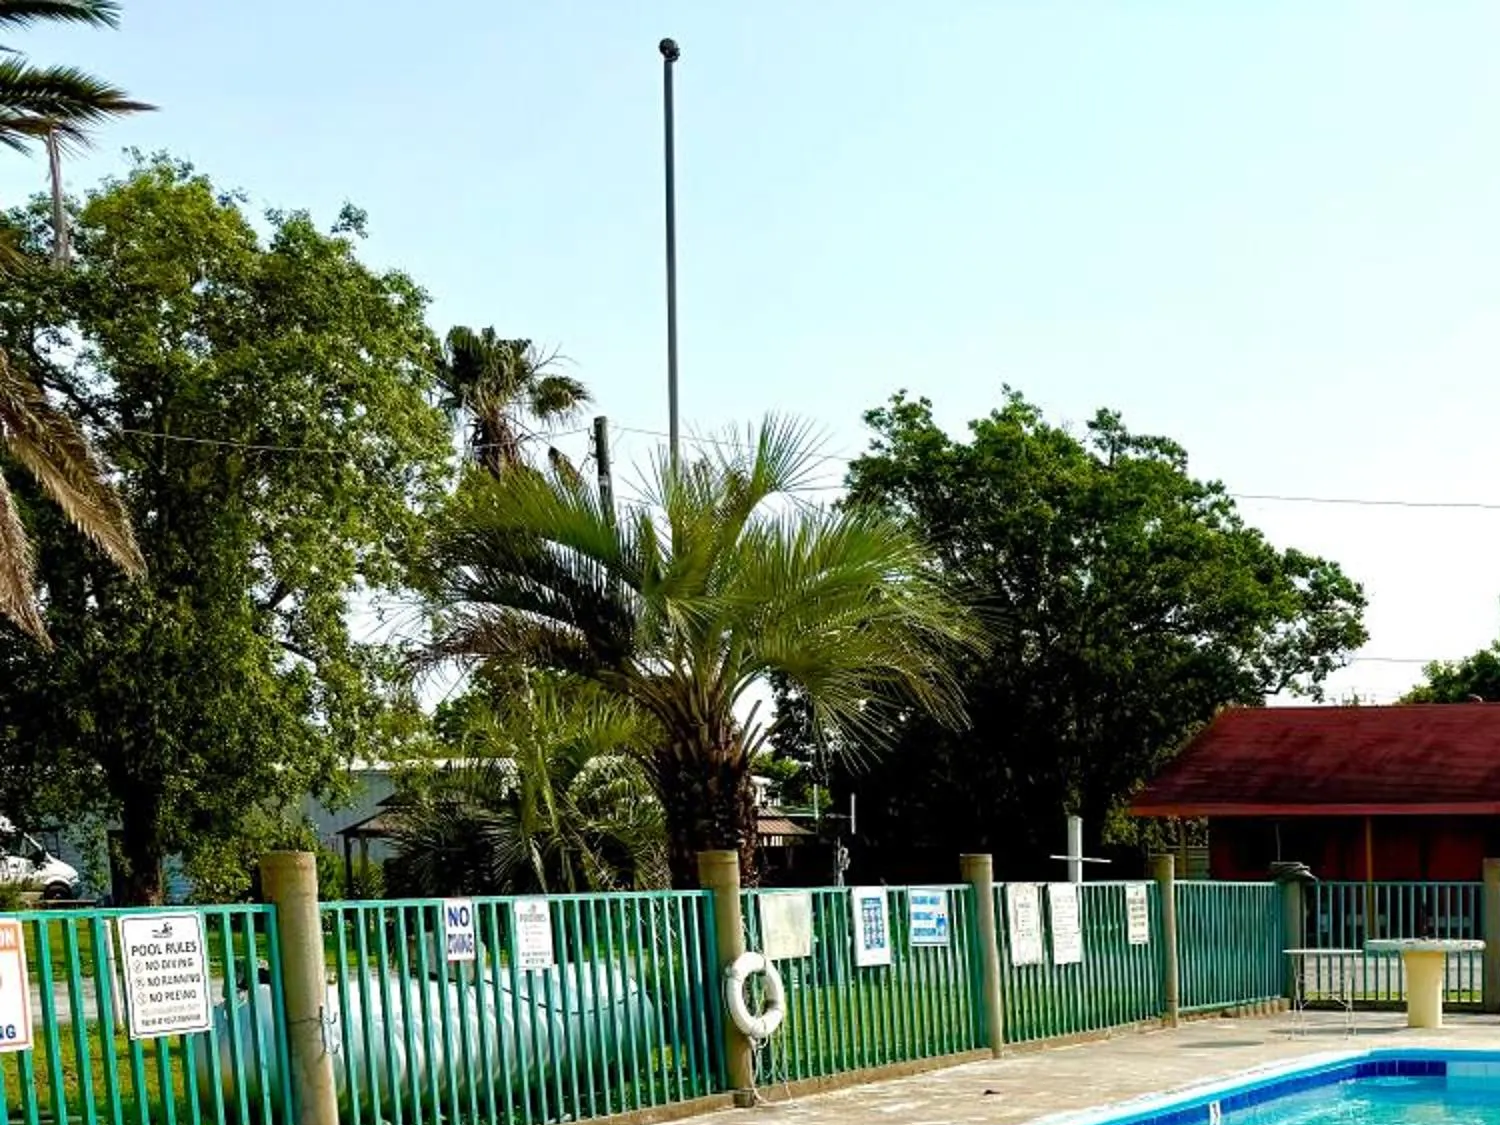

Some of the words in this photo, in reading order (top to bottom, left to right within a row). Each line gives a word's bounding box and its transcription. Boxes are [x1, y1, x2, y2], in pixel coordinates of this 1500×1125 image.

[447, 906, 470, 928] NO
[131, 943, 163, 957] POOL
[165, 940, 198, 955] RULES
[145, 960, 161, 971] NO
[147, 976, 161, 987] NO
[149, 991, 163, 1002] NO
